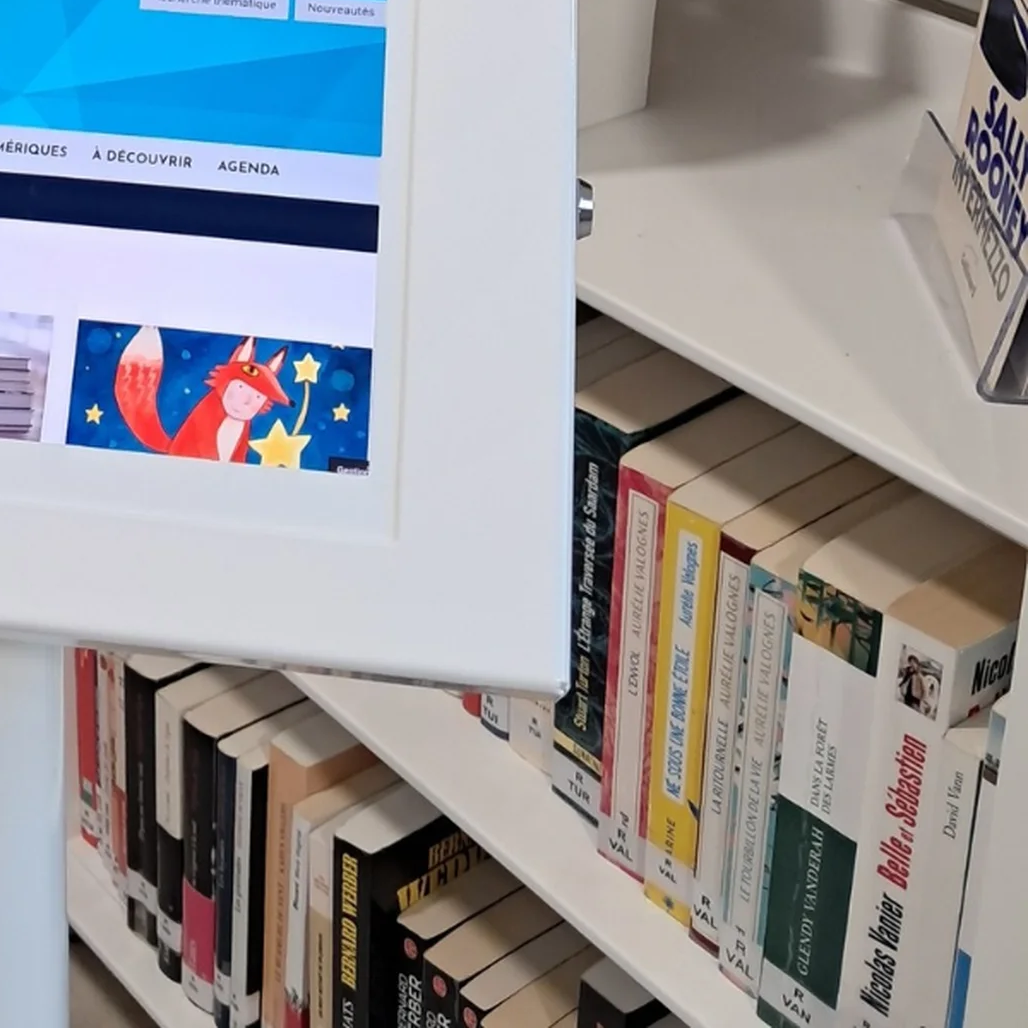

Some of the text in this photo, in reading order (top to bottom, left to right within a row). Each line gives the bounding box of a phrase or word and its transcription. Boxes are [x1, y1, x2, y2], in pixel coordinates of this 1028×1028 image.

[307, 2, 376, 18] Nouveautés
[91, 145, 193, 169] À DÉCOUVRIR
[217, 159, 281, 177] AGENDA
[583, 461, 600, 519] Saardam
[582, 518, 598, 539] du
[577, 540, 598, 596] Traversée
[680, 540, 700, 586] Valognes
[627, 509, 651, 698] L'ENVOL AURÉLIE VALOGNES
[575, 655, 591, 692] Turton
[971, 641, 1017, 697] Nicol
[573, 692, 591, 732] Stuart
[671, 685, 689, 723] BONNE
[712, 573, 741, 815] LA RITOURNELLE AURÉLIE VALOGNES
[669, 722, 685, 747] UNE
[667, 746, 684, 778] SOUS
[739, 612, 776, 904] LE TOURBILLON DE LA VIE AURÉLIE VALOGNES
[810, 717, 829, 808] DANS LA FORÊT
[568, 778, 591, 805] TUR
[574, 771, 584, 784] R
[665, 782, 681, 799] NE
[821, 745, 838, 816] DES LARMES
[884, 733, 928, 829] Sébastien
[942, 770, 965, 841] David Vann
[608, 837, 633, 862] VAL
[617, 828, 627, 843] R
[899, 826, 915, 845] et
[658, 864, 677, 885] VAL
[664, 858, 673, 869] R
[876, 834, 914, 891] Belle
[692, 904, 718, 931] VAL
[701, 894, 712, 911] R
[796, 825, 825, 977] GLENDY VANDERAH
[340, 851, 360, 991] BERNARD WERBER
[868, 890, 904, 952] Vanier
[725, 947, 755, 981] VAL
[734, 939, 746, 957] R
[397, 972, 409, 1028] ERNARD
[407, 974, 423, 1028] RBER
[793, 987, 805, 1003] R
[859, 947, 897, 1018] Nicolas
[781, 993, 812, 1024] VAN
